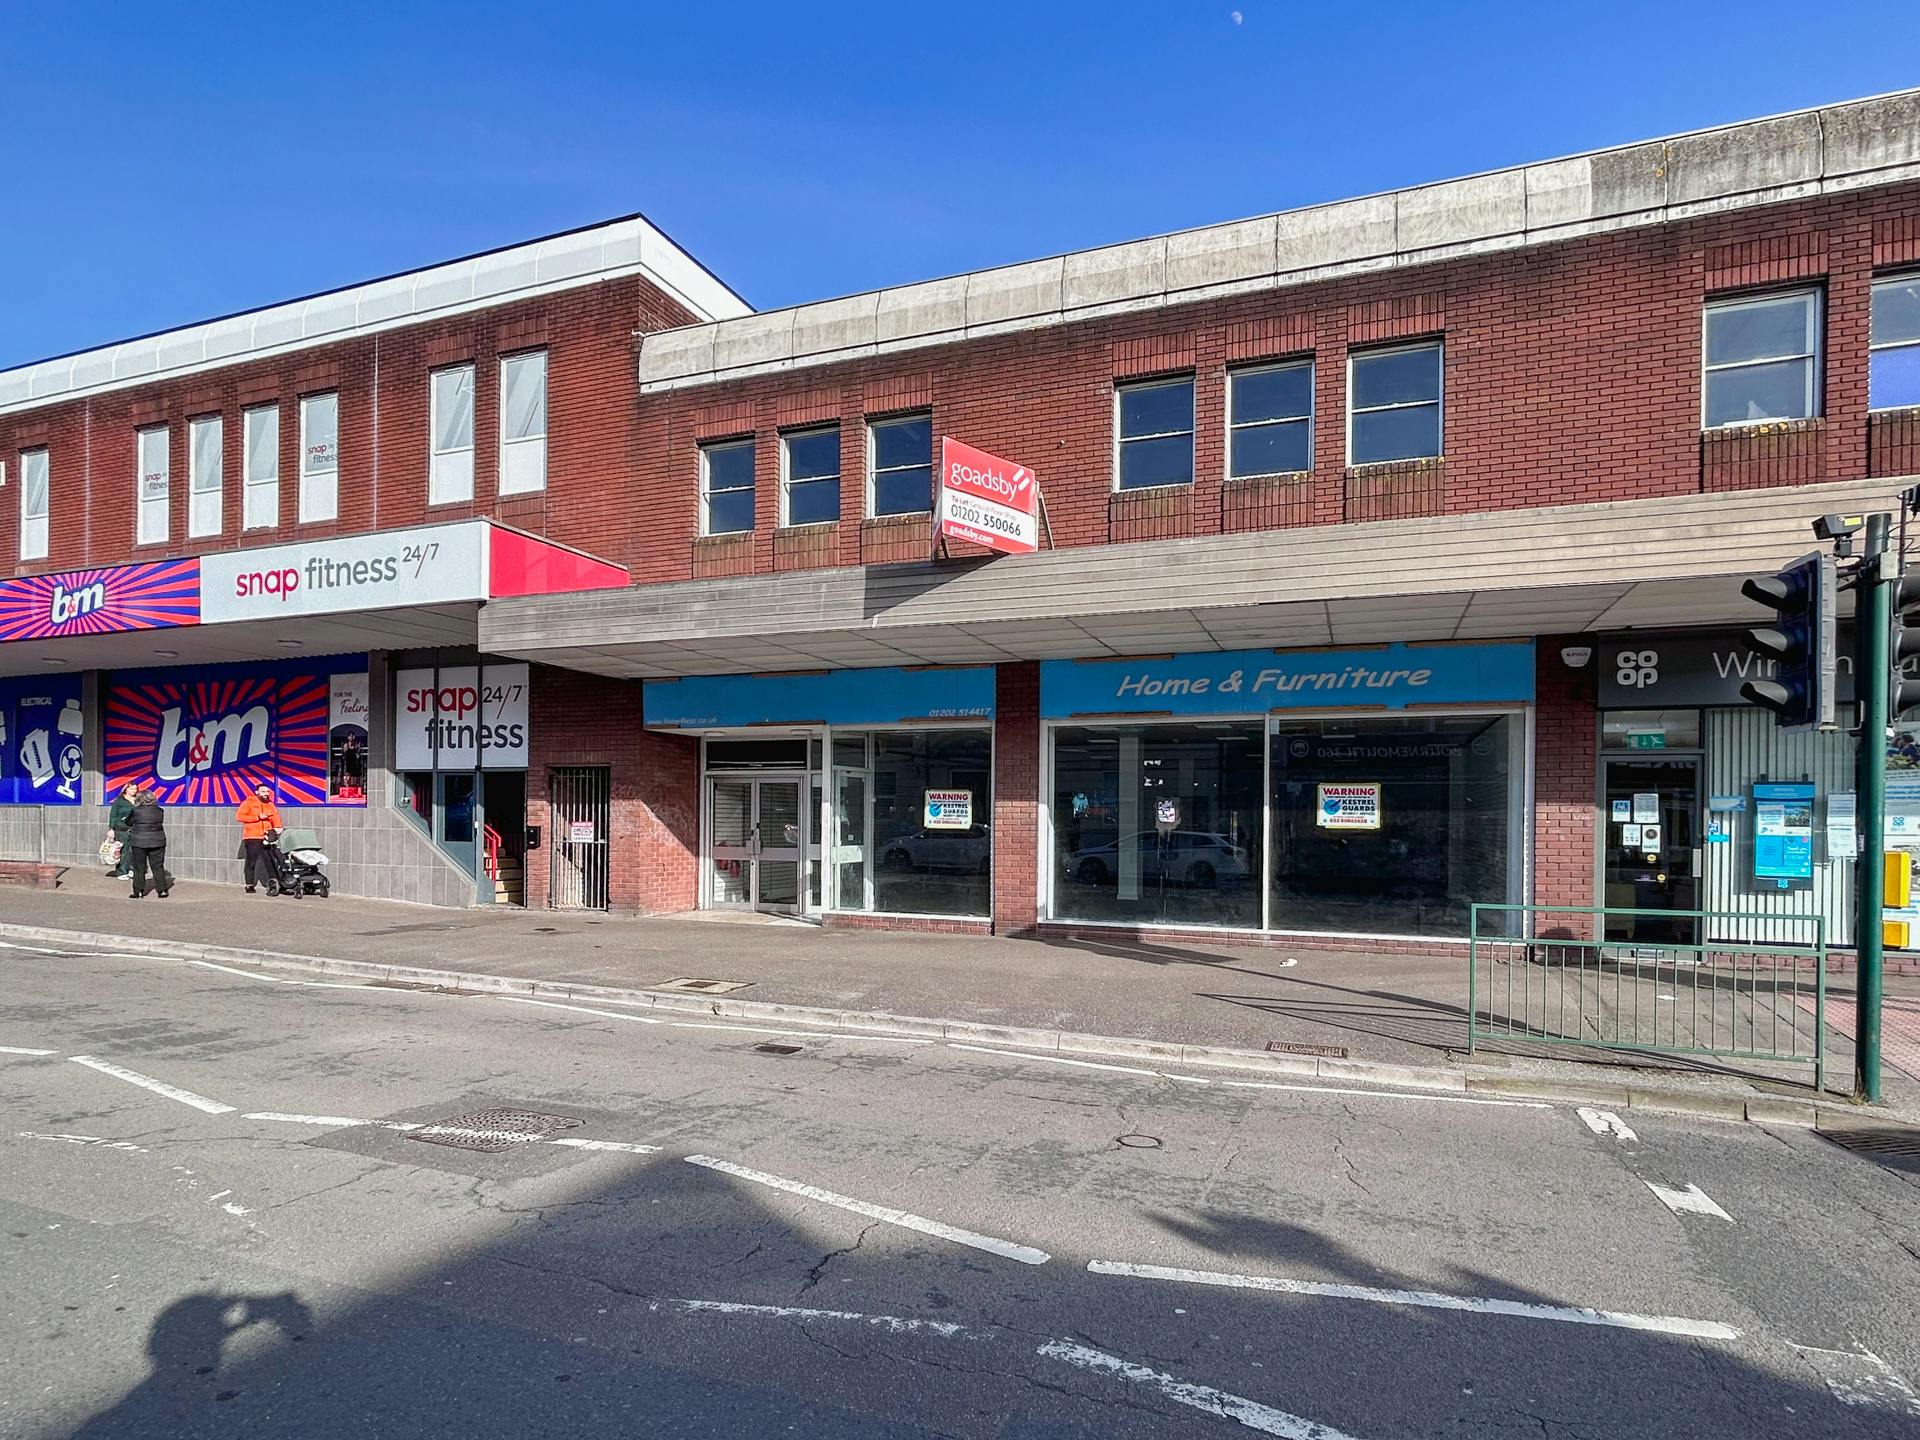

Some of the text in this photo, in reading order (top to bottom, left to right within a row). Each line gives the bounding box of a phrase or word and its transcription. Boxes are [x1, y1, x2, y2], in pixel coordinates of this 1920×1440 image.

[307, 444, 327, 455] snap
[951, 463, 1018, 502] goadsby
[949, 526, 994, 545] goadsby.com
[951, 504, 980, 524] 01202
[984, 514, 1021, 536] 550066
[236, 543, 440, 601] snap fitness 24/7
[51, 583, 105, 624] b&m
[1117, 666, 1432, 697] Home & Furniture
[406, 685, 523, 720] snap 24/7
[929, 709, 956, 718] 01202
[156, 706, 271, 781] b&m
[424, 718, 524, 749] fitness
[1323, 788, 1376, 796] WARNING
